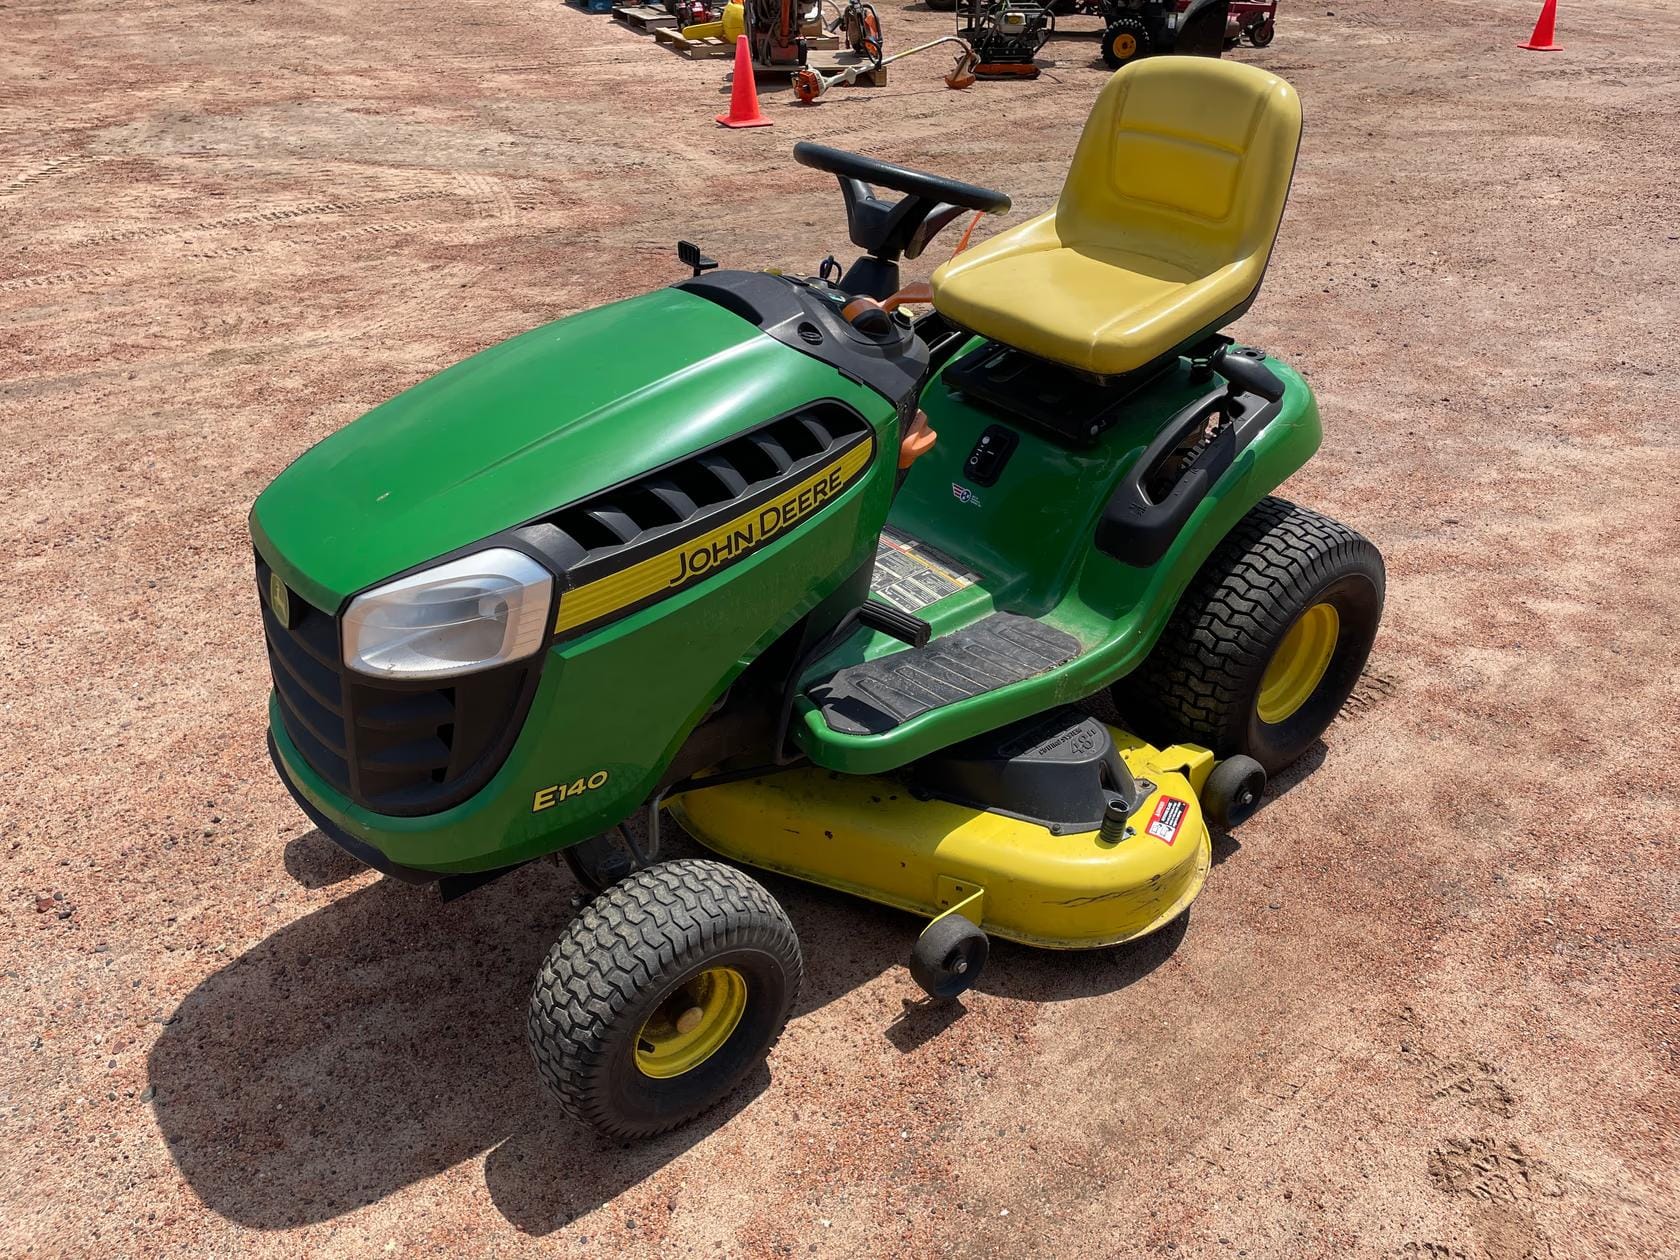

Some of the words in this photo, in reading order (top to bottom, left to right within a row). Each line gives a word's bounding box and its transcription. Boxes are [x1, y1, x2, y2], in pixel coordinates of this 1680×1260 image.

[669, 522, 755, 586] JOHN
[759, 466, 843, 539] DEERE
[532, 769, 609, 812] E140
